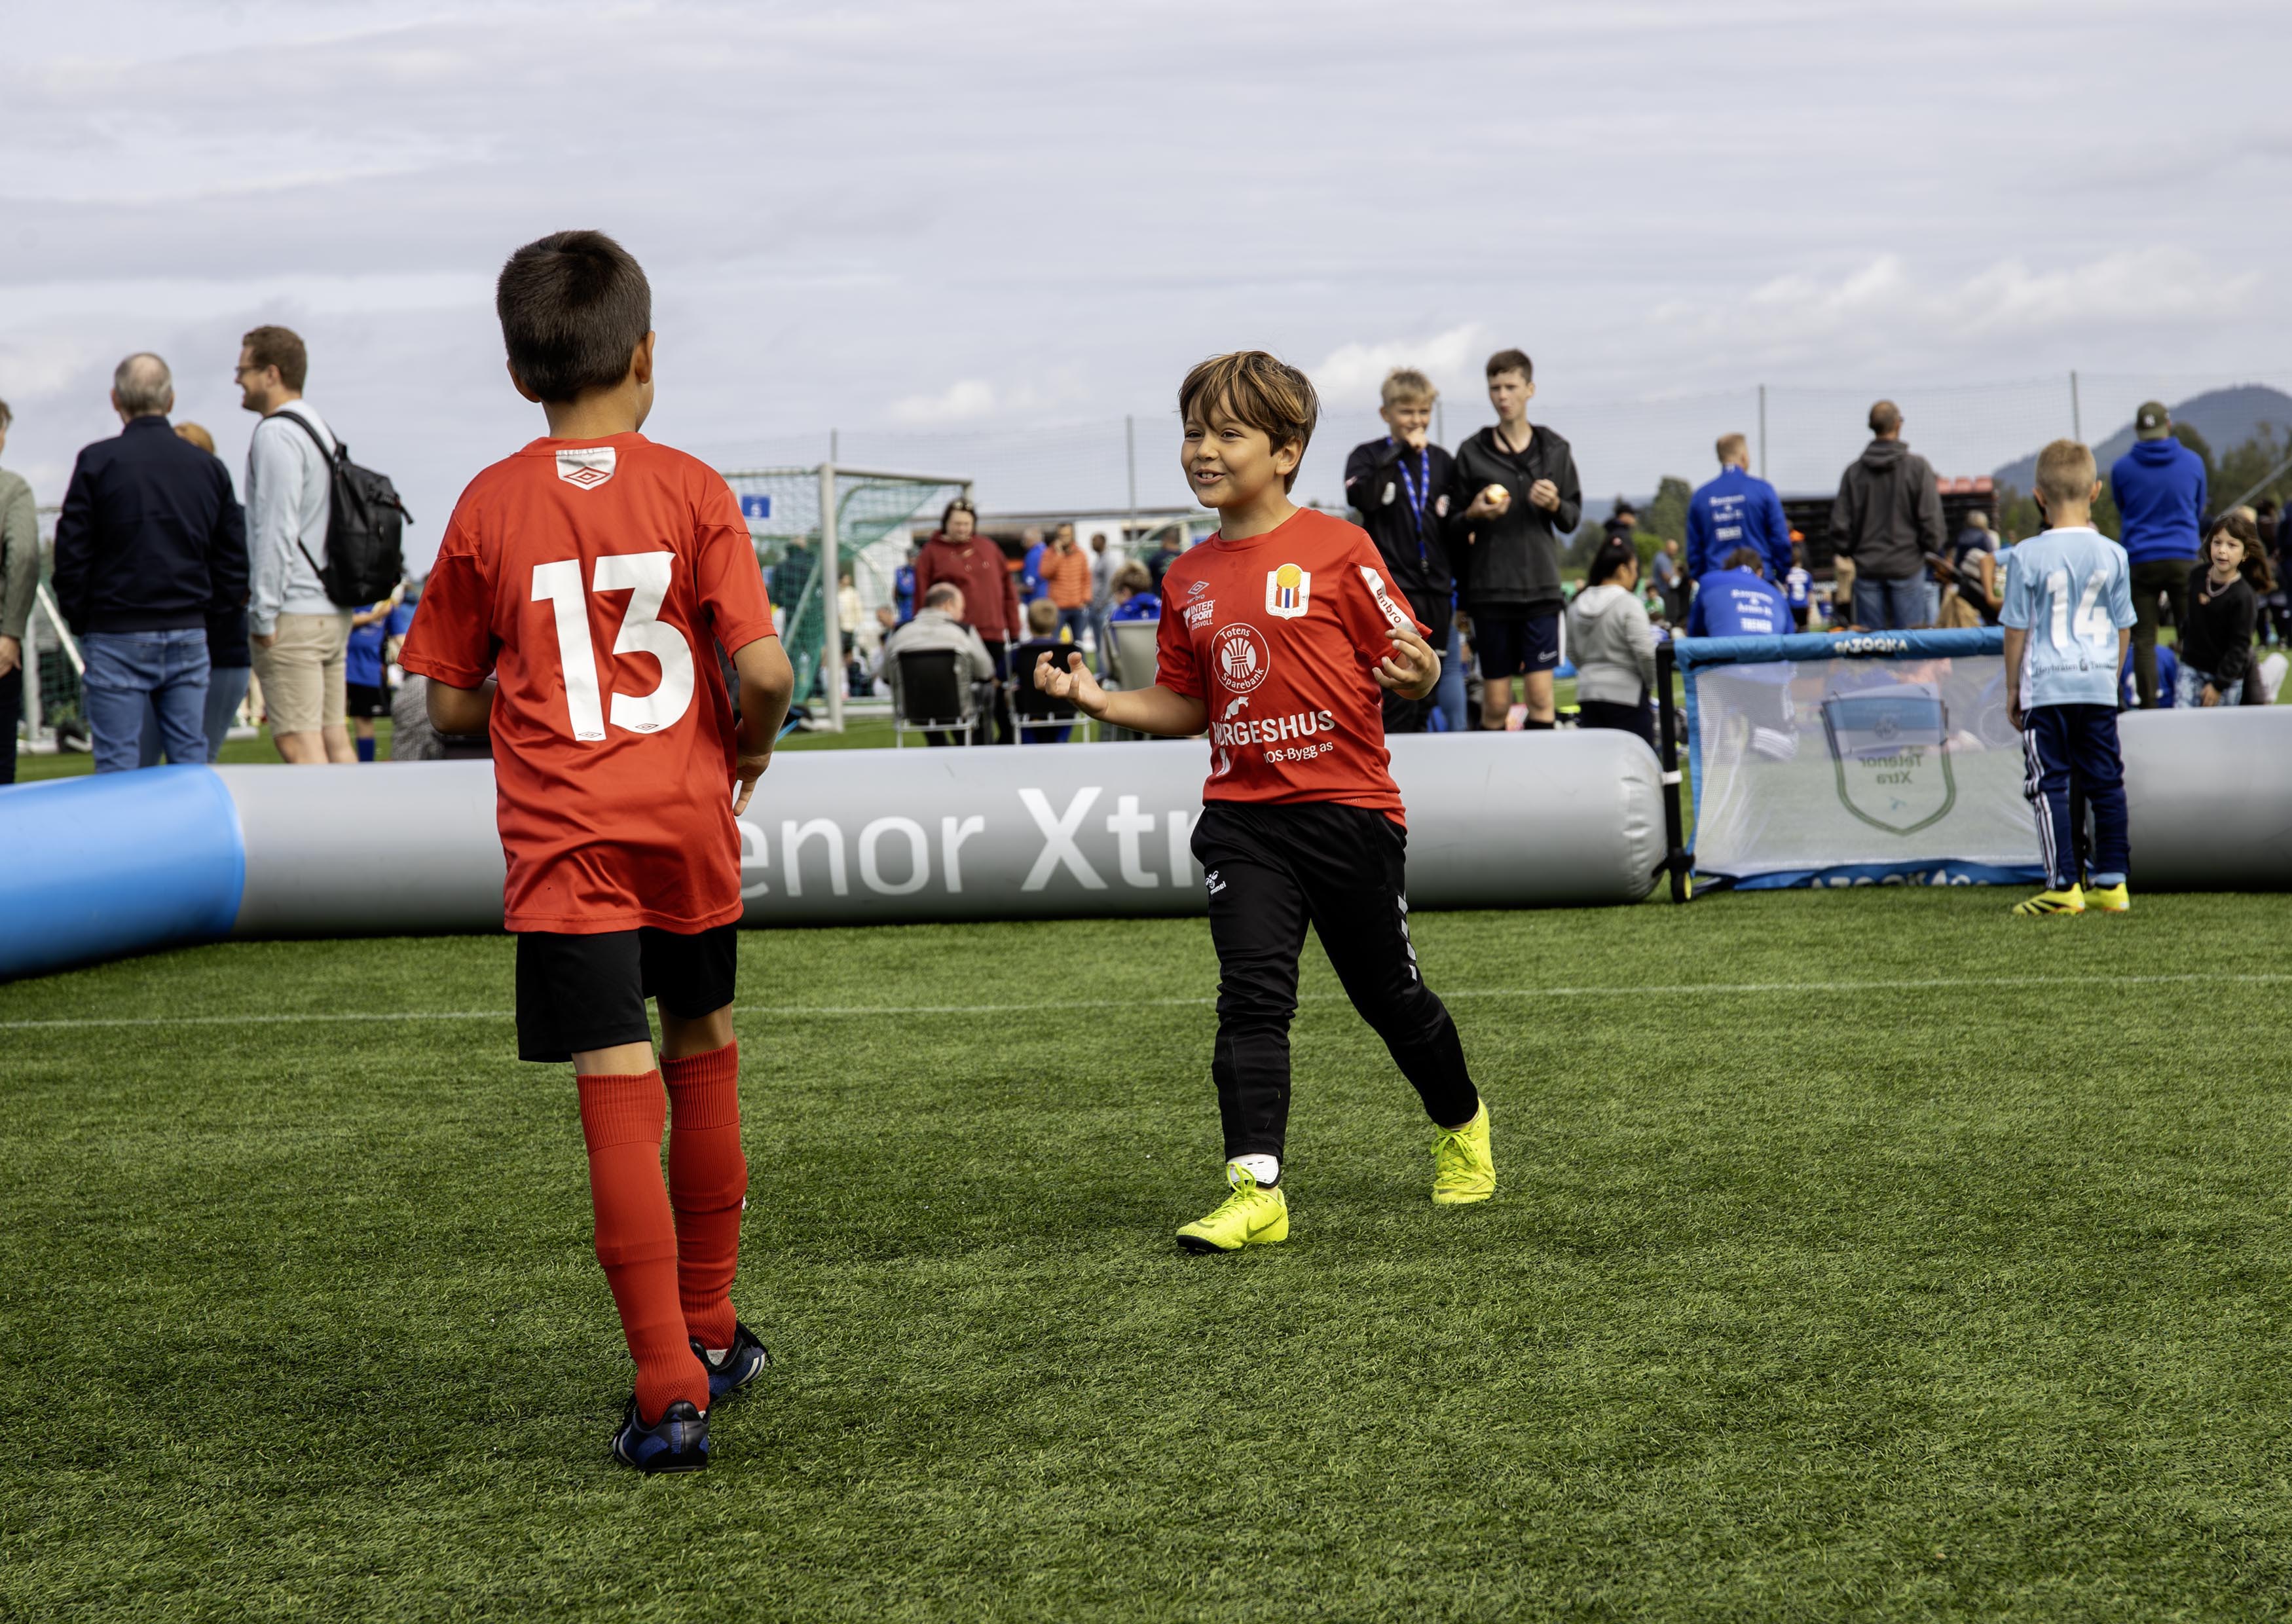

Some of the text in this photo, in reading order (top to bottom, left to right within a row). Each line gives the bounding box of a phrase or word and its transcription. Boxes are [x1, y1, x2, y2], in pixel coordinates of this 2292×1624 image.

[1191, 600, 1213, 615] INTER
[1191, 609, 1213, 623] SPORT
[1377, 588, 1401, 623] umbro
[2047, 568, 2111, 648] 14
[530, 550, 695, 741] 13
[1219, 627, 1251, 640] Totens
[1222, 667, 1265, 690] Sparebank
[1211, 710, 1335, 747] NORGESHUS
[1263, 742, 1333, 764] OS-Bygg as
[740, 786, 1206, 900] enor Xtr
